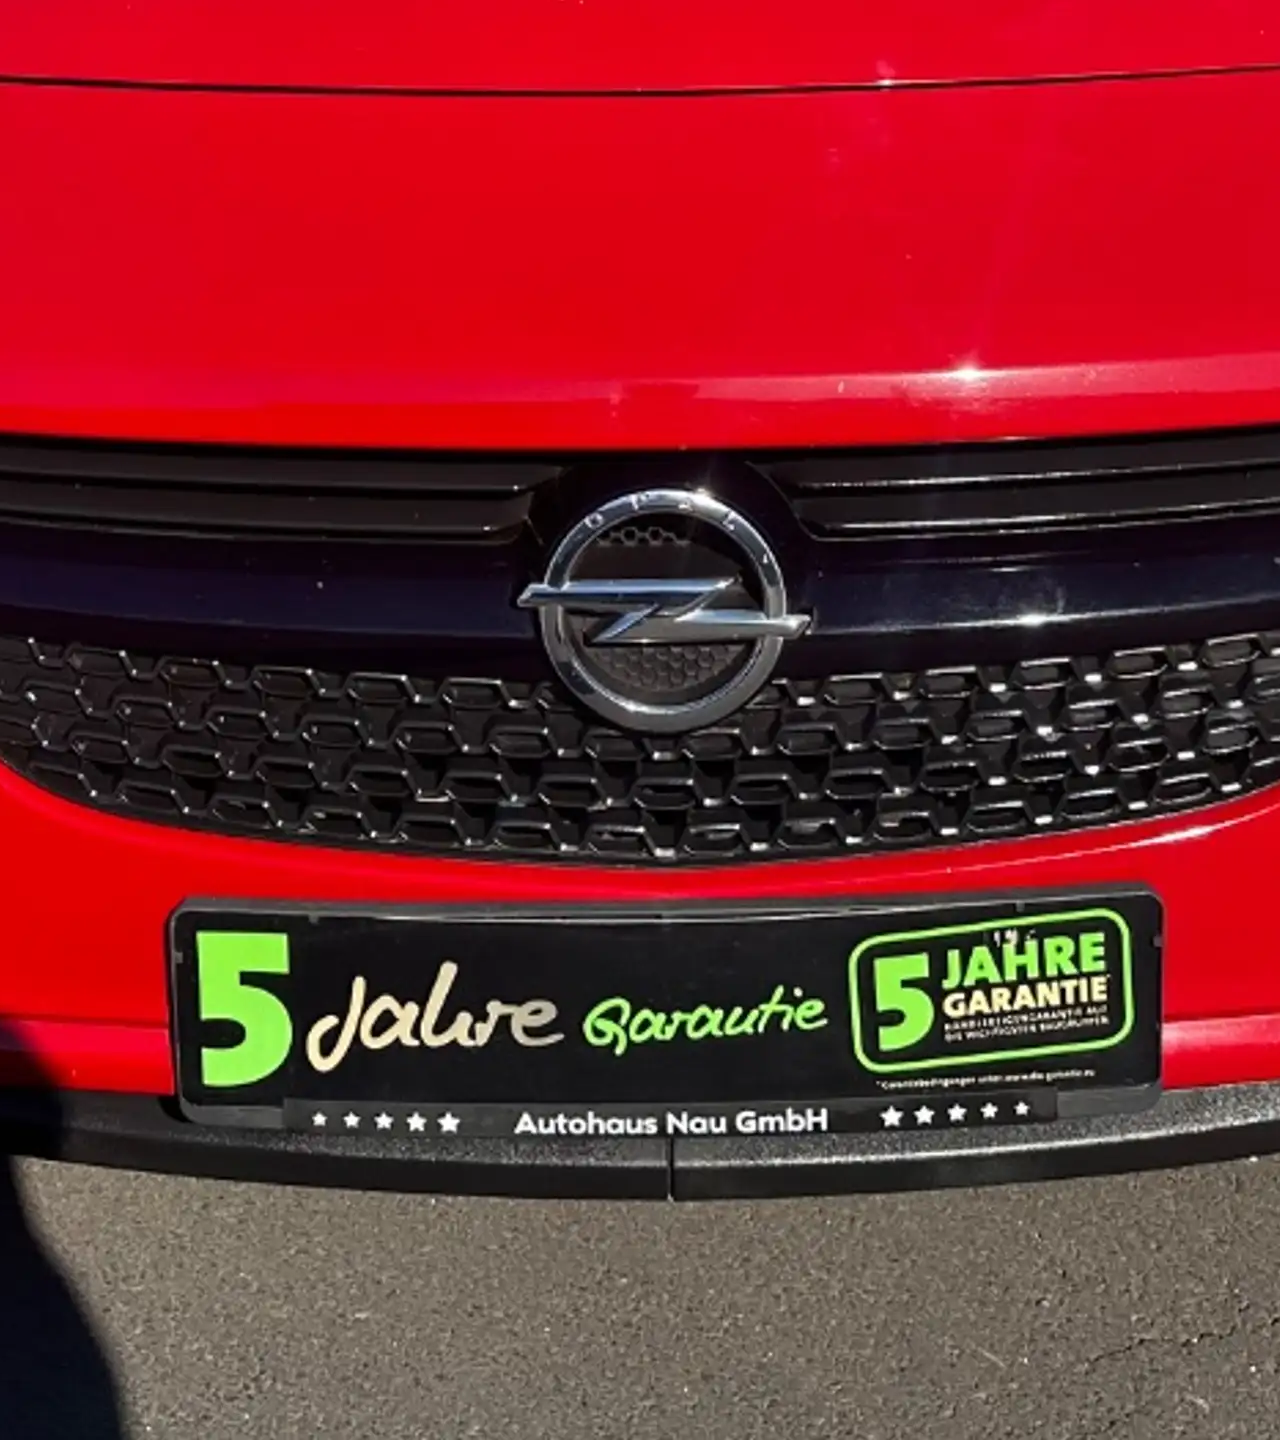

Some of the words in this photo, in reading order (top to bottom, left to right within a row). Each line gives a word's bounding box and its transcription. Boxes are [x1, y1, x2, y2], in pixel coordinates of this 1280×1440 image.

[941, 931, 1107, 990] JAHRE
[196, 931, 293, 1087] 5
[306, 961, 565, 1073] Jahre
[583, 985, 829, 1055] Garantie
[873, 952, 935, 1052] 5
[514, 1110, 658, 1137] Autohaus
[666, 1111, 727, 1136] Nau
[735, 1108, 829, 1134] GmbH
